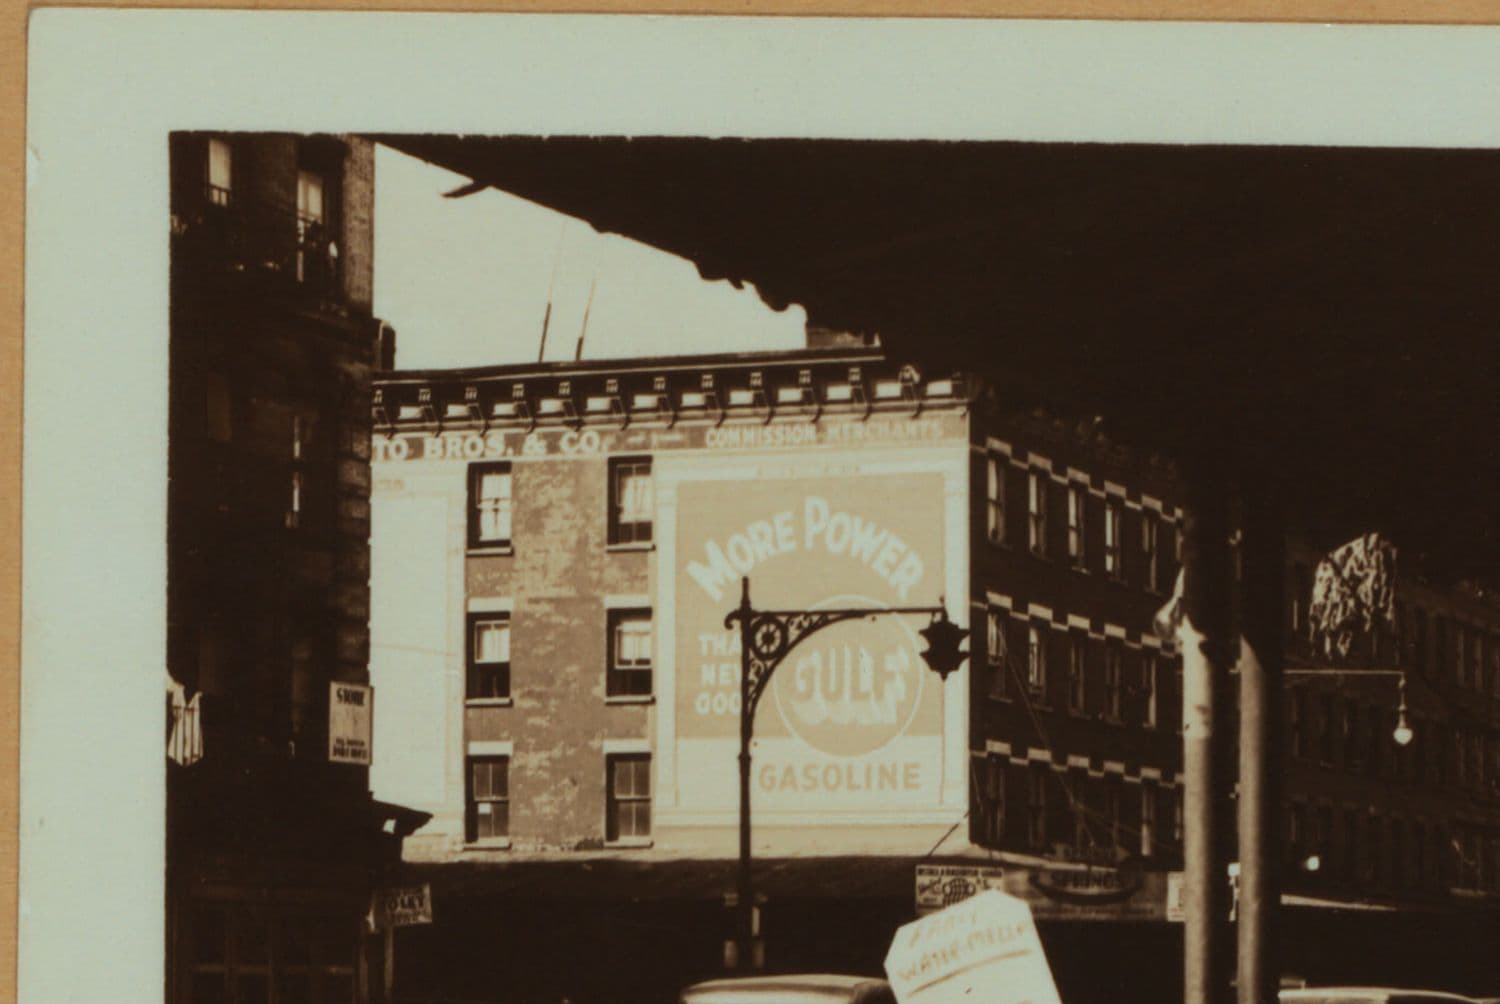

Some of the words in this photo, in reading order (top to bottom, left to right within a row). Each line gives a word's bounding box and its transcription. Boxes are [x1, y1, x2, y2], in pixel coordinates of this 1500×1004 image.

[423, 430, 514, 459] BROS.
[521, 429, 547, 457] &
[705, 424, 817, 448] COMMISSION
[686, 510, 797, 601] MORE
[804, 496, 924, 600] POWER
[698, 632, 742, 657] THA
[791, 643, 909, 725] GULF
[695, 692, 742, 716] GOO
[759, 761, 922, 794] GASOLINE
